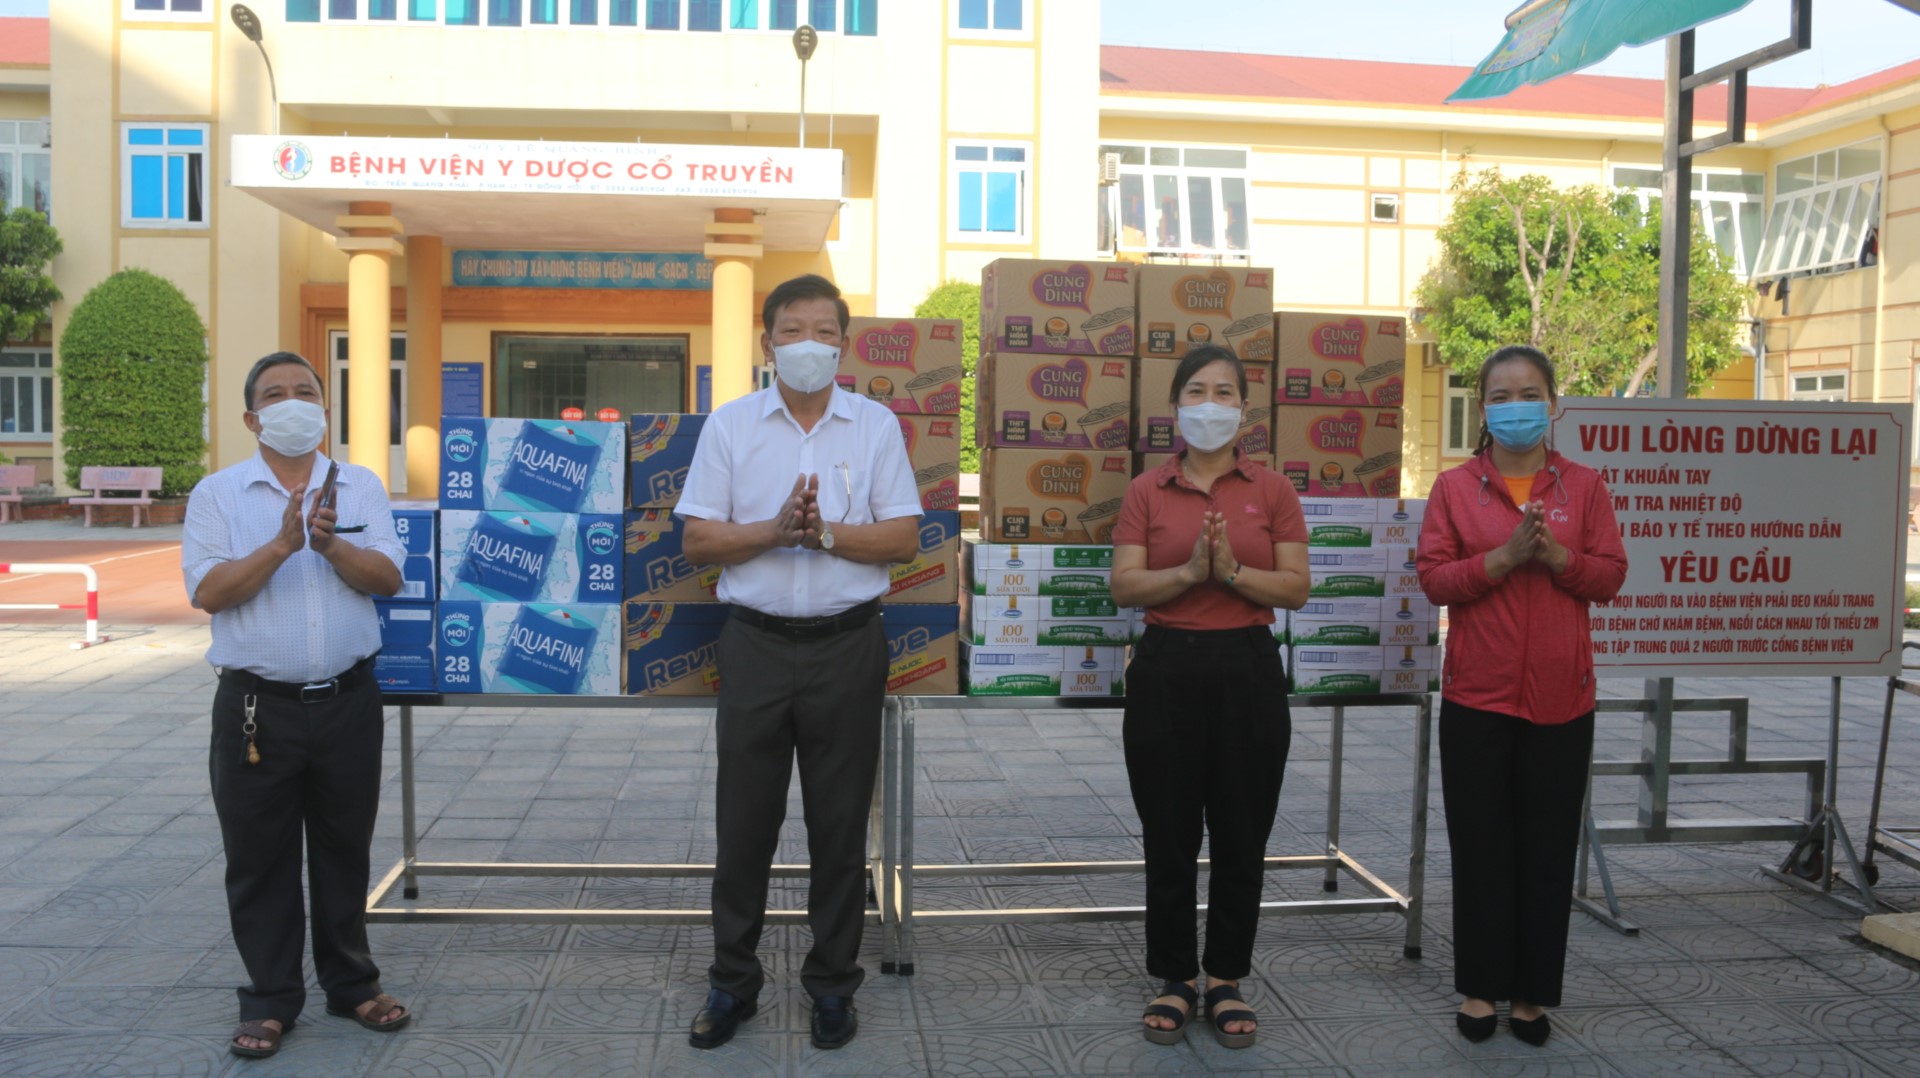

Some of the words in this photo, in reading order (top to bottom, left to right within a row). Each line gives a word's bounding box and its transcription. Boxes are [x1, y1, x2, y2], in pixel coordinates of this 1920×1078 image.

[330, 151, 406, 177] BỆNH
[419, 154, 484, 179] VIỆN
[498, 159, 513, 176] Y
[525, 158, 613, 183] DƯỢC
[627, 154, 673, 180] CỔ
[686, 157, 793, 183] TRUYỀN
[481, 259, 512, 277] CHUNG
[514, 259, 528, 277] TAY
[577, 257, 600, 281] BỆNH
[1042, 273, 1085, 288] CUNG
[1184, 280, 1227, 294] CUNG
[1045, 288, 1082, 303] ĐÌNH
[866, 333, 910, 347] CUNG
[1103, 332, 1130, 346] CUNG
[1321, 327, 1360, 342] CUNG
[1040, 369, 1082, 383] CUNG
[1042, 383, 1080, 397] ĐÌNH
[928, 391, 957, 405] CUNG
[448, 427, 474, 437] THÙNG
[1100, 427, 1127, 440] CUNG
[1319, 420, 1358, 434] CUNG
[1241, 431, 1266, 444] CUNG
[1321, 434, 1356, 448] ĐÌNH
[1579, 424, 1630, 452] VUI
[1641, 419, 1725, 454] LÒNG
[1735, 421, 1820, 455] DỪNG
[1830, 428, 1877, 461] LẠI
[450, 443, 470, 453] MỚI
[510, 439, 588, 490] AQUAFINA
[1040, 464, 1083, 479] CUNG
[447, 471, 473, 488] 28
[1597, 465, 1619, 484] ÁT
[1624, 463, 1679, 484] KHUẨN
[1685, 469, 1711, 484] TAY
[447, 489, 473, 499] CHAI
[927, 487, 955, 501] CUNG
[1042, 479, 1080, 494] ĐÌNH
[1634, 496, 1664, 511] TRA
[1669, 493, 1716, 514] NHIỆT
[1720, 493, 1742, 514] ĐỘ
[396, 518, 410, 534] 8
[590, 520, 615, 530] THÙNG
[1630, 519, 1662, 538] BÁO
[1668, 522, 1678, 538] Y
[1683, 517, 1702, 537] TẾ
[1706, 522, 1745, 538] THEO
[1751, 520, 1804, 538] HƯỚNG
[1809, 517, 1842, 538] DẪN
[592, 536, 611, 546] MỚI
[466, 530, 543, 580] AQUAFINA
[588, 563, 615, 580] 28
[1659, 551, 1718, 583] YÊU
[1729, 546, 1791, 583] CẦU
[589, 581, 614, 591] CHAI
[1612, 595, 1632, 611] MỌI
[1635, 592, 1667, 608] NGƯỜI
[1670, 595, 1684, 608] RA
[1687, 592, 1706, 608] VÀO
[1709, 592, 1737, 611] BỆNH
[1739, 592, 1762, 611] VIỆN
[1765, 591, 1788, 608] PHẢI
[1791, 595, 1811, 607] ĐEO
[1813, 589, 1840, 607] KHẨU
[1843, 594, 1875, 607] TRANG
[445, 612, 470, 621] THÙNG
[1608, 615, 1636, 634] BỆNH
[1639, 614, 1661, 631] CHỜ
[1663, 614, 1693, 630] KHÁM
[1695, 614, 1726, 634] BỆNH,
[1756, 614, 1783, 630] CÁCH
[1786, 617, 1812, 630] NHAU
[1815, 612, 1830, 630] TỐI
[1833, 611, 1861, 630] THIỂU
[1863, 617, 1879, 629] 2M
[447, 628, 466, 638] MỚI
[506, 623, 584, 673] AQUAFINA
[1611, 638, 1630, 656] TẬP
[1633, 641, 1667, 654] TRUNG
[1669, 638, 1690, 654] QUÁ
[1693, 641, 1699, 653] 2
[1702, 637, 1733, 653] NGƯỜI
[1737, 636, 1768, 653] TRƯỚC
[1771, 635, 1799, 653] CỔNG
[1801, 637, 1828, 655] BỆNH
[1831, 637, 1854, 655] VIỆN
[444, 655, 470, 672] 28
[445, 673, 470, 683] CHAI
